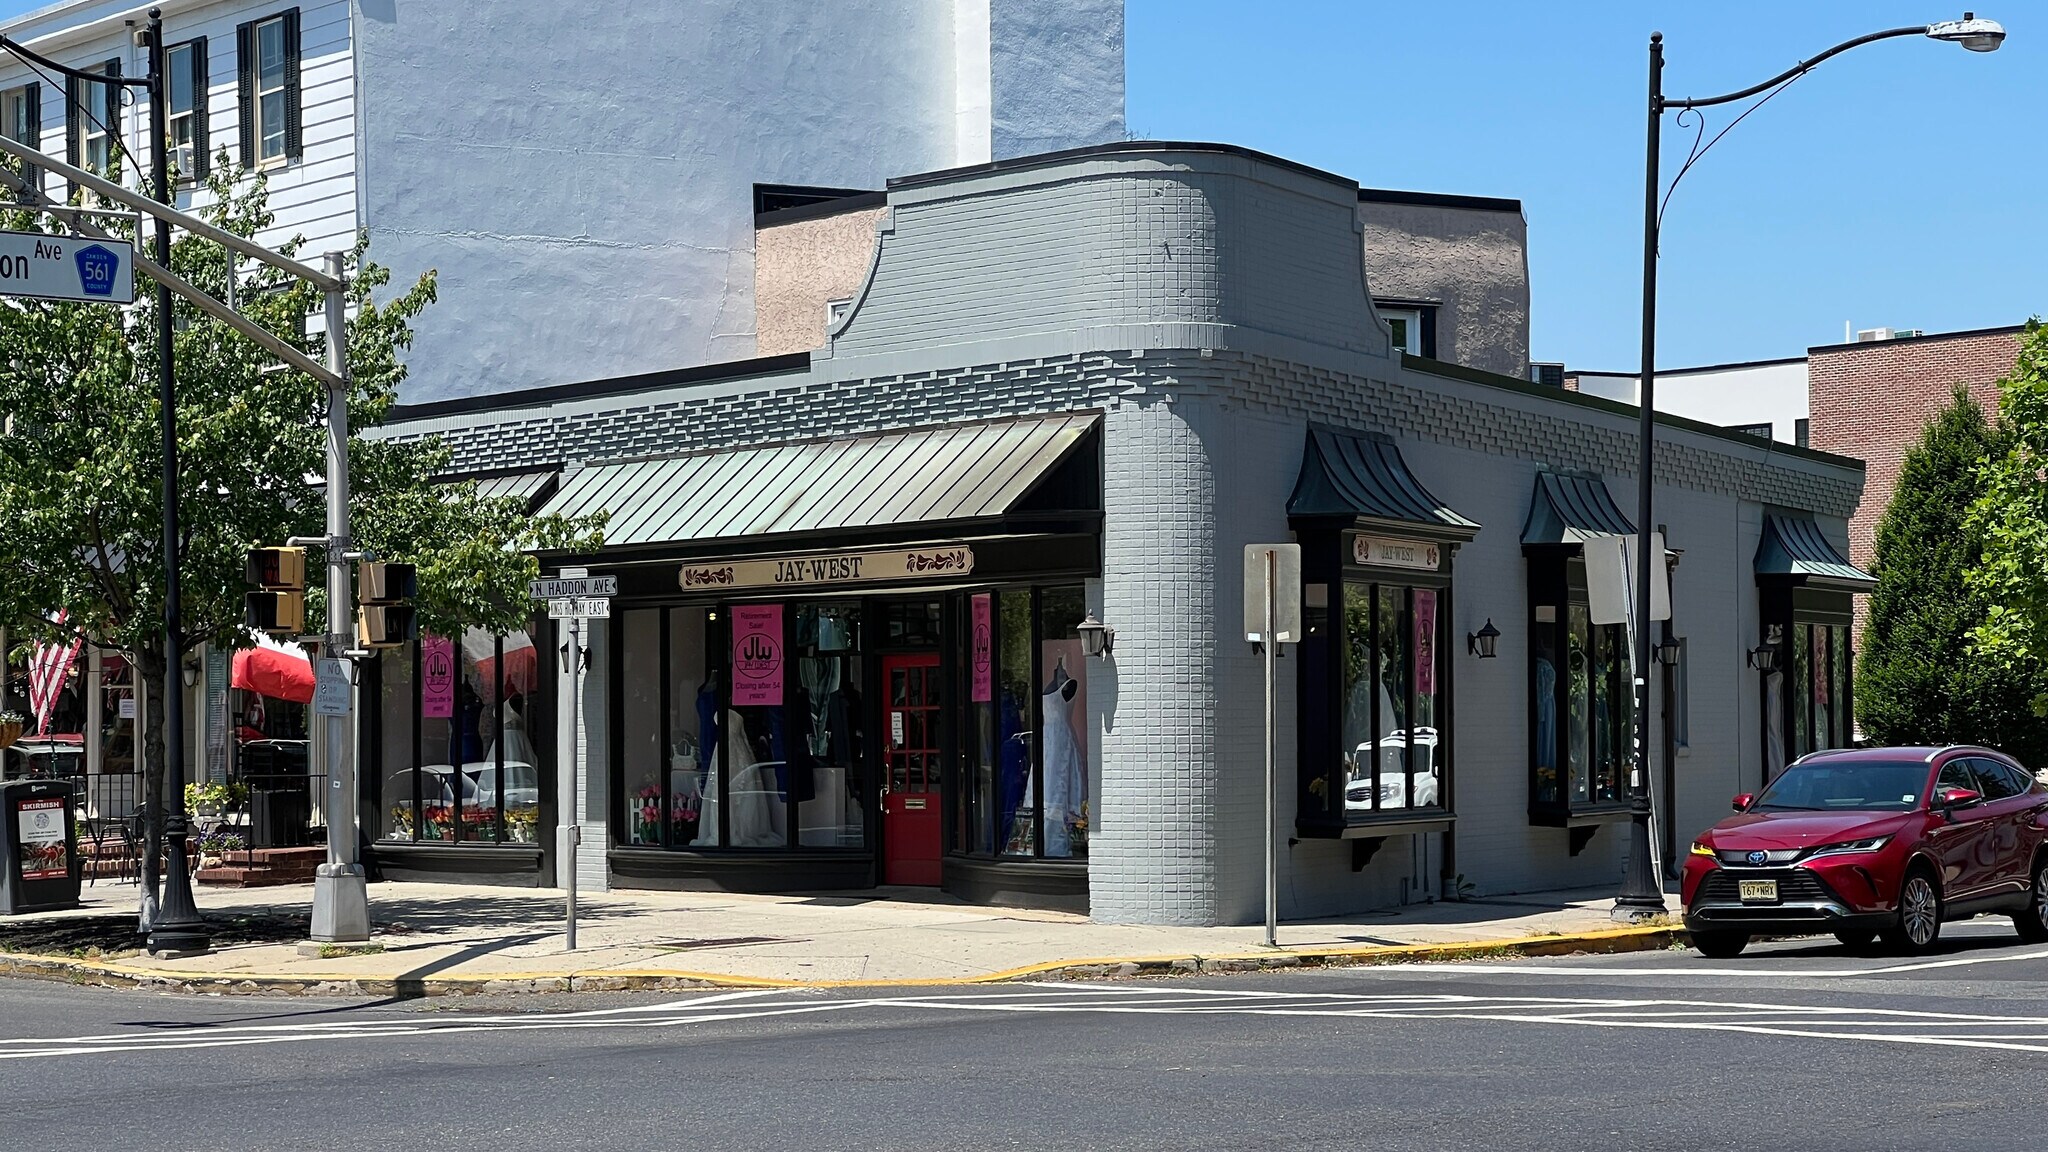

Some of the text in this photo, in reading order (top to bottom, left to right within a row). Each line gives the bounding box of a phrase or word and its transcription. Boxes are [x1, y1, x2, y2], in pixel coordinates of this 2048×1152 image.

[34, 239, 63, 261] Ave
[85, 261, 109, 281] 561
[1381, 545, 1414, 562] JAY-WEST
[775, 556, 863, 583] JAY-WEST
[535, 579, 610, 597] N. HADDON AVE
[588, 601, 605, 615] EAST
[327, 663, 341, 675] NO
[735, 682, 757, 691] Closing
[22, 801, 60, 810] SKIRMISH
